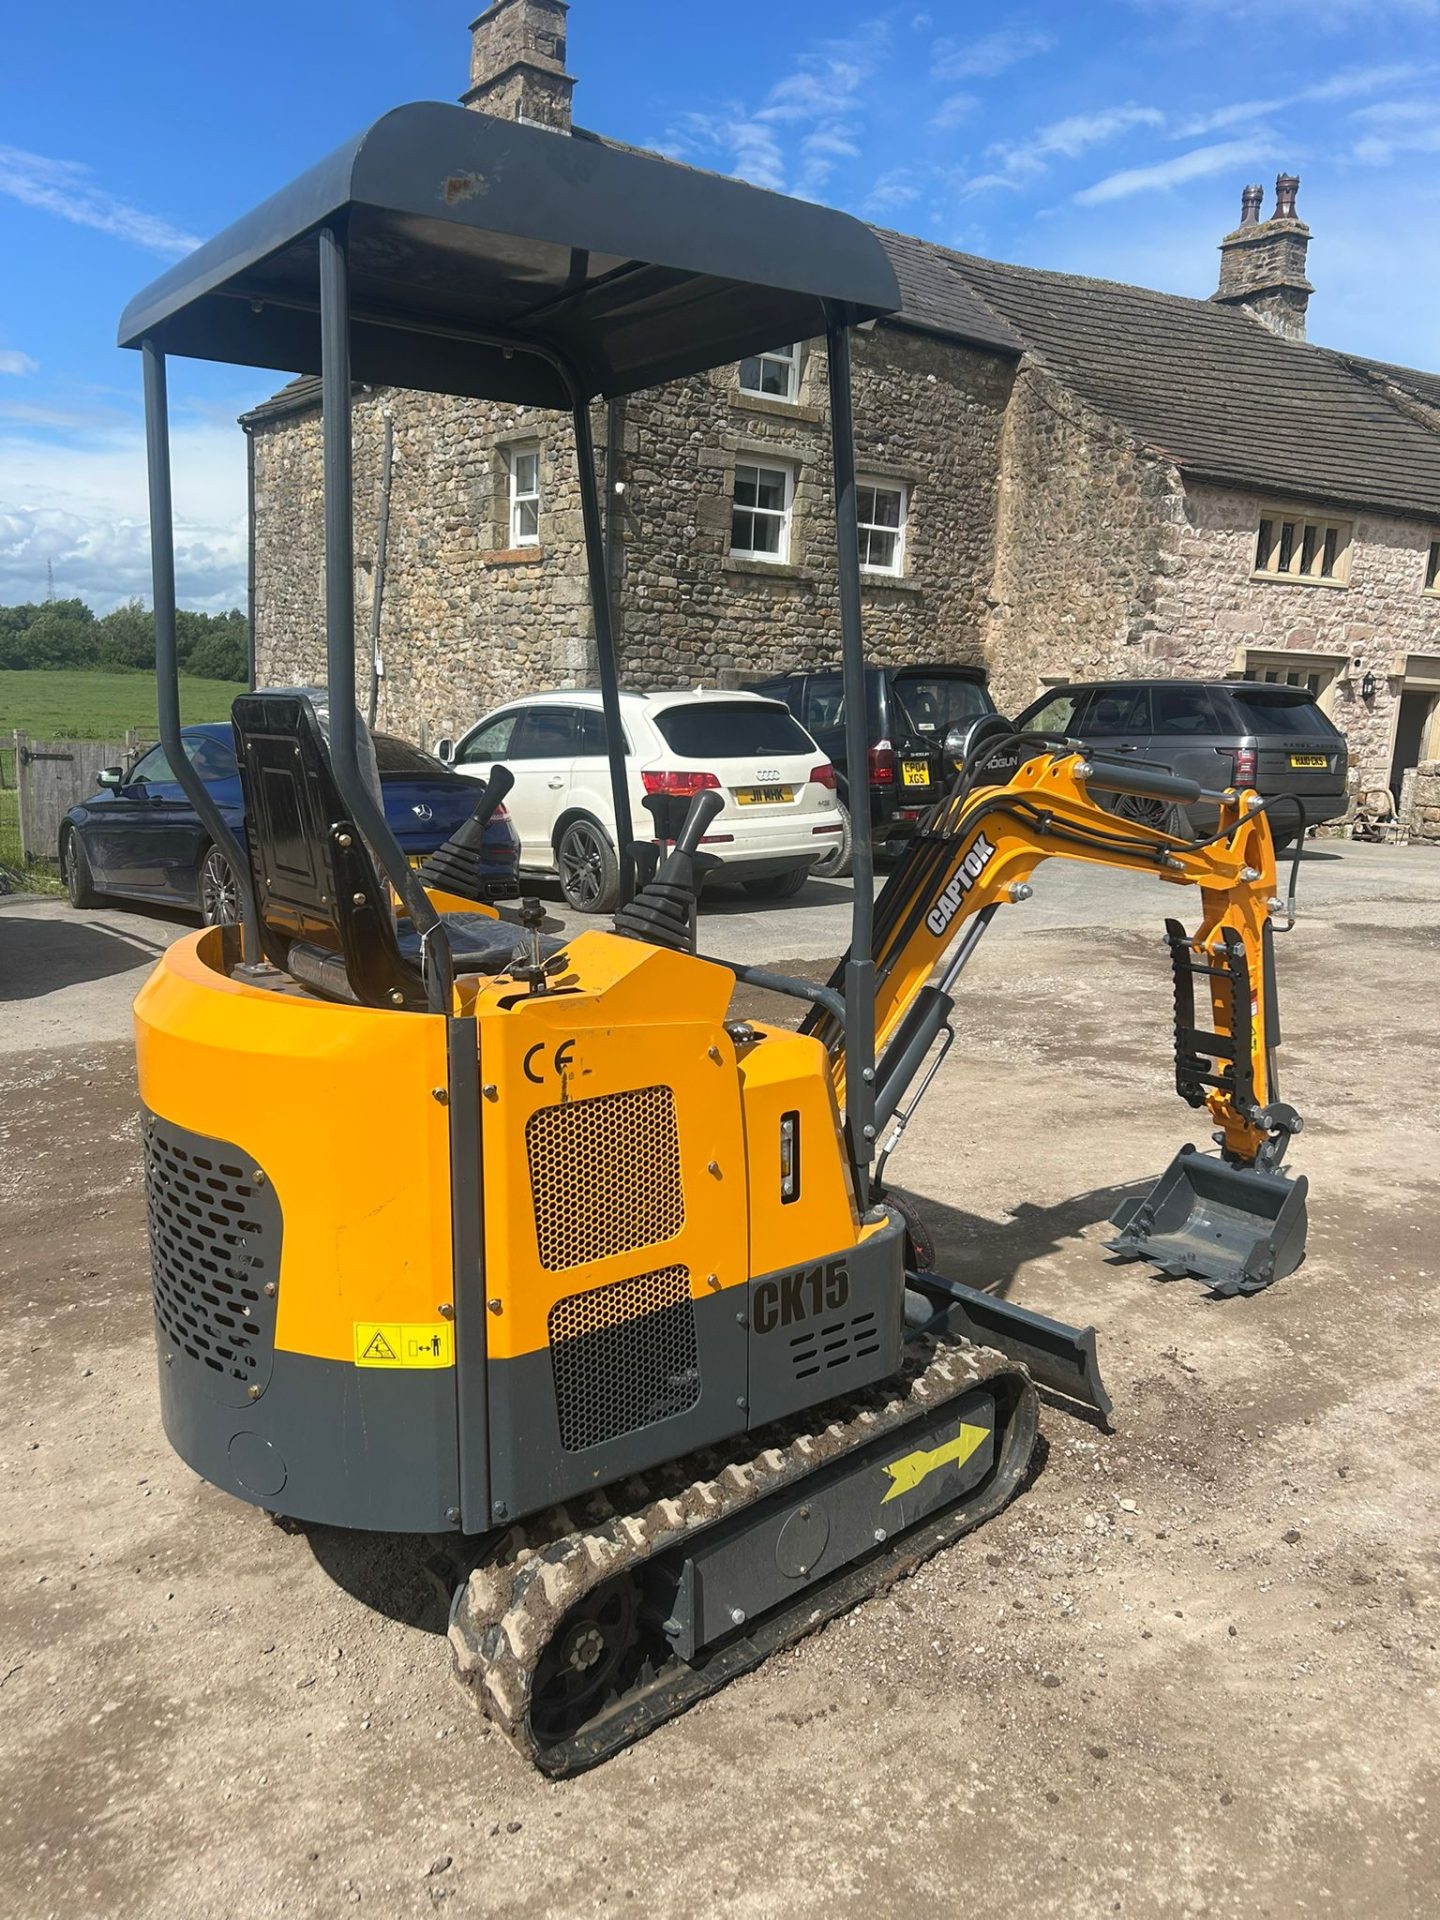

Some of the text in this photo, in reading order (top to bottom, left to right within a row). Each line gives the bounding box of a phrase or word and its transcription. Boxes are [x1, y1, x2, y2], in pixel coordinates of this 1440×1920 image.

[908, 773, 926, 784] XGS
[926, 832, 996, 936] CAPTOK
[523, 1038, 576, 1084] CE
[753, 1258, 849, 1335] CK15
